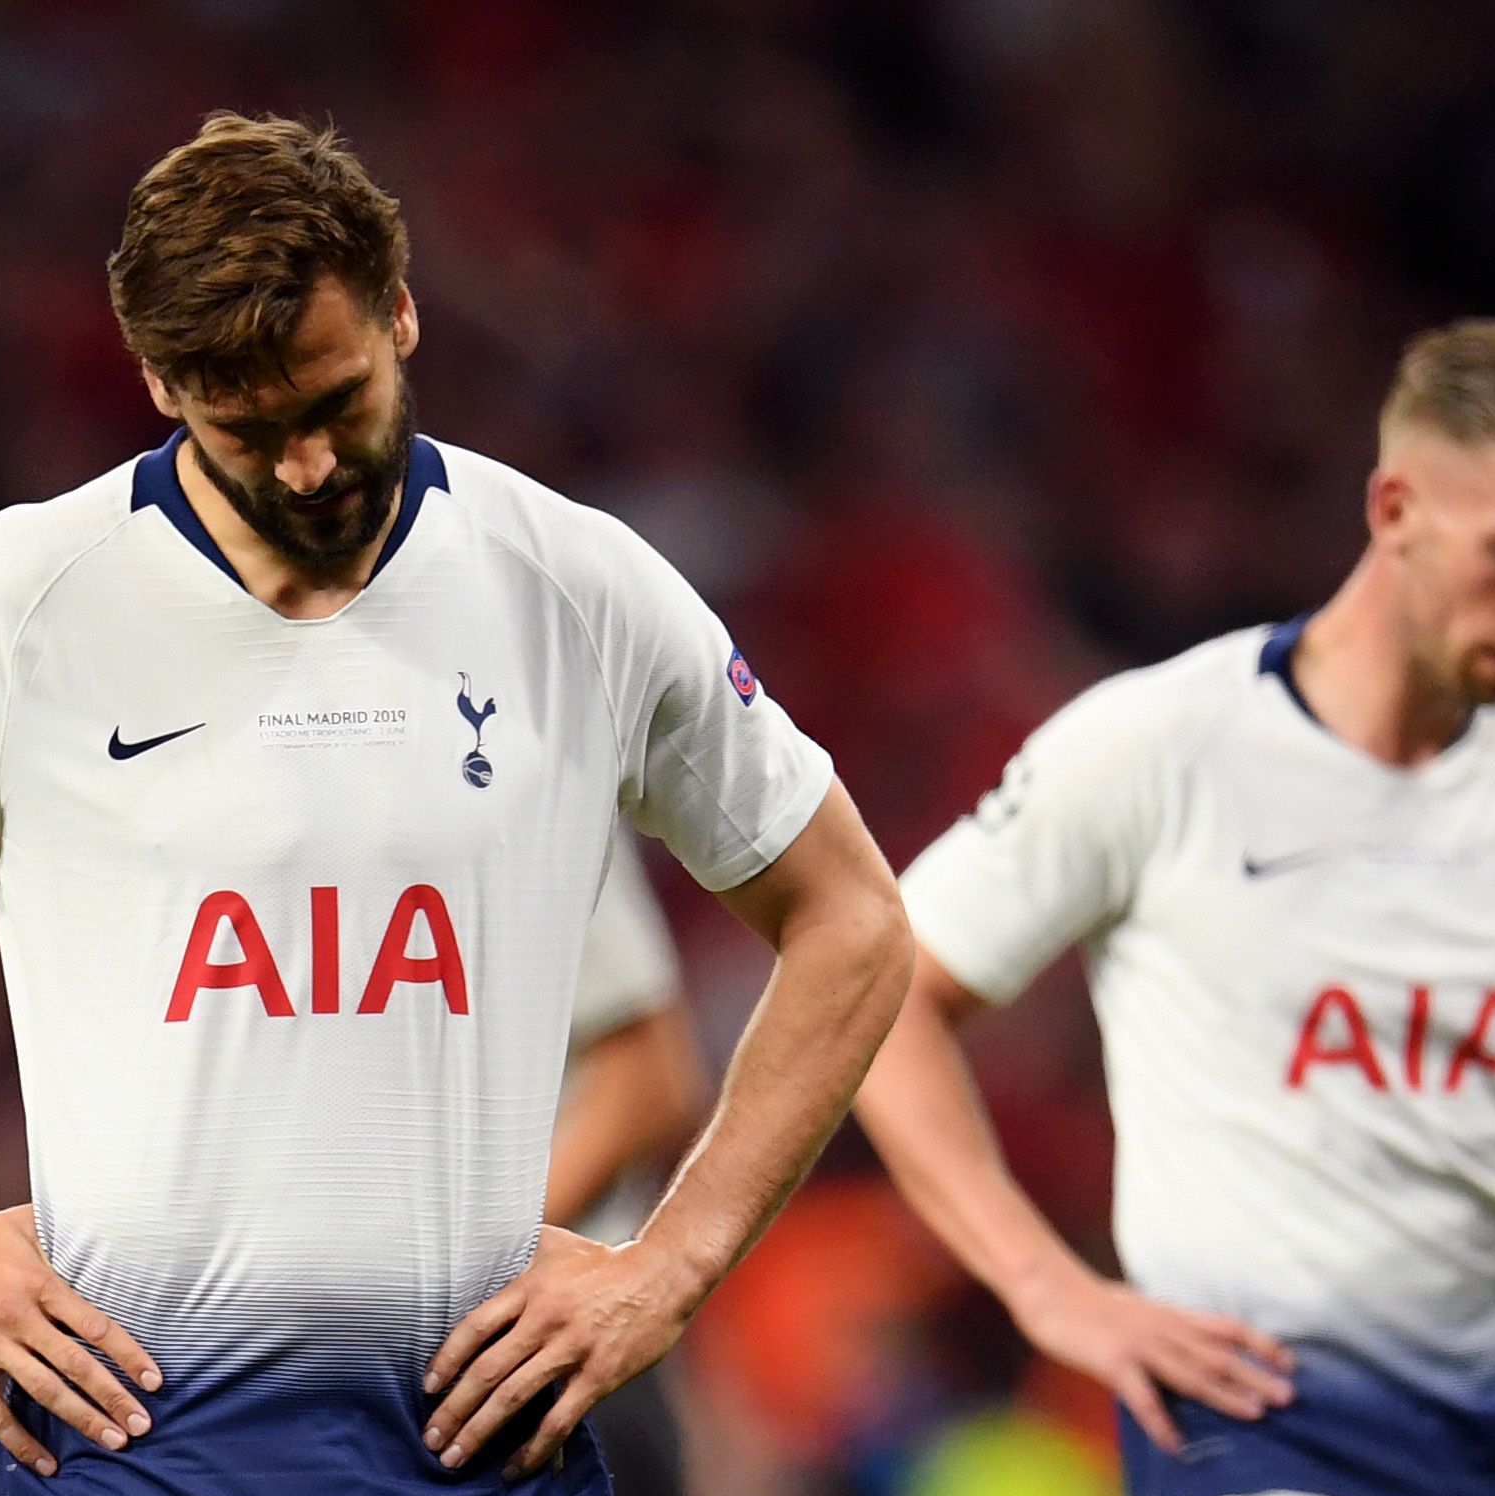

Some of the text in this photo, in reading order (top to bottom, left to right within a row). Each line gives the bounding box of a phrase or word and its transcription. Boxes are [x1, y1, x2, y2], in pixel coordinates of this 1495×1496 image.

[258, 709, 406, 727] FINAL MADRID 2019
[164, 884, 469, 1022] AIA
